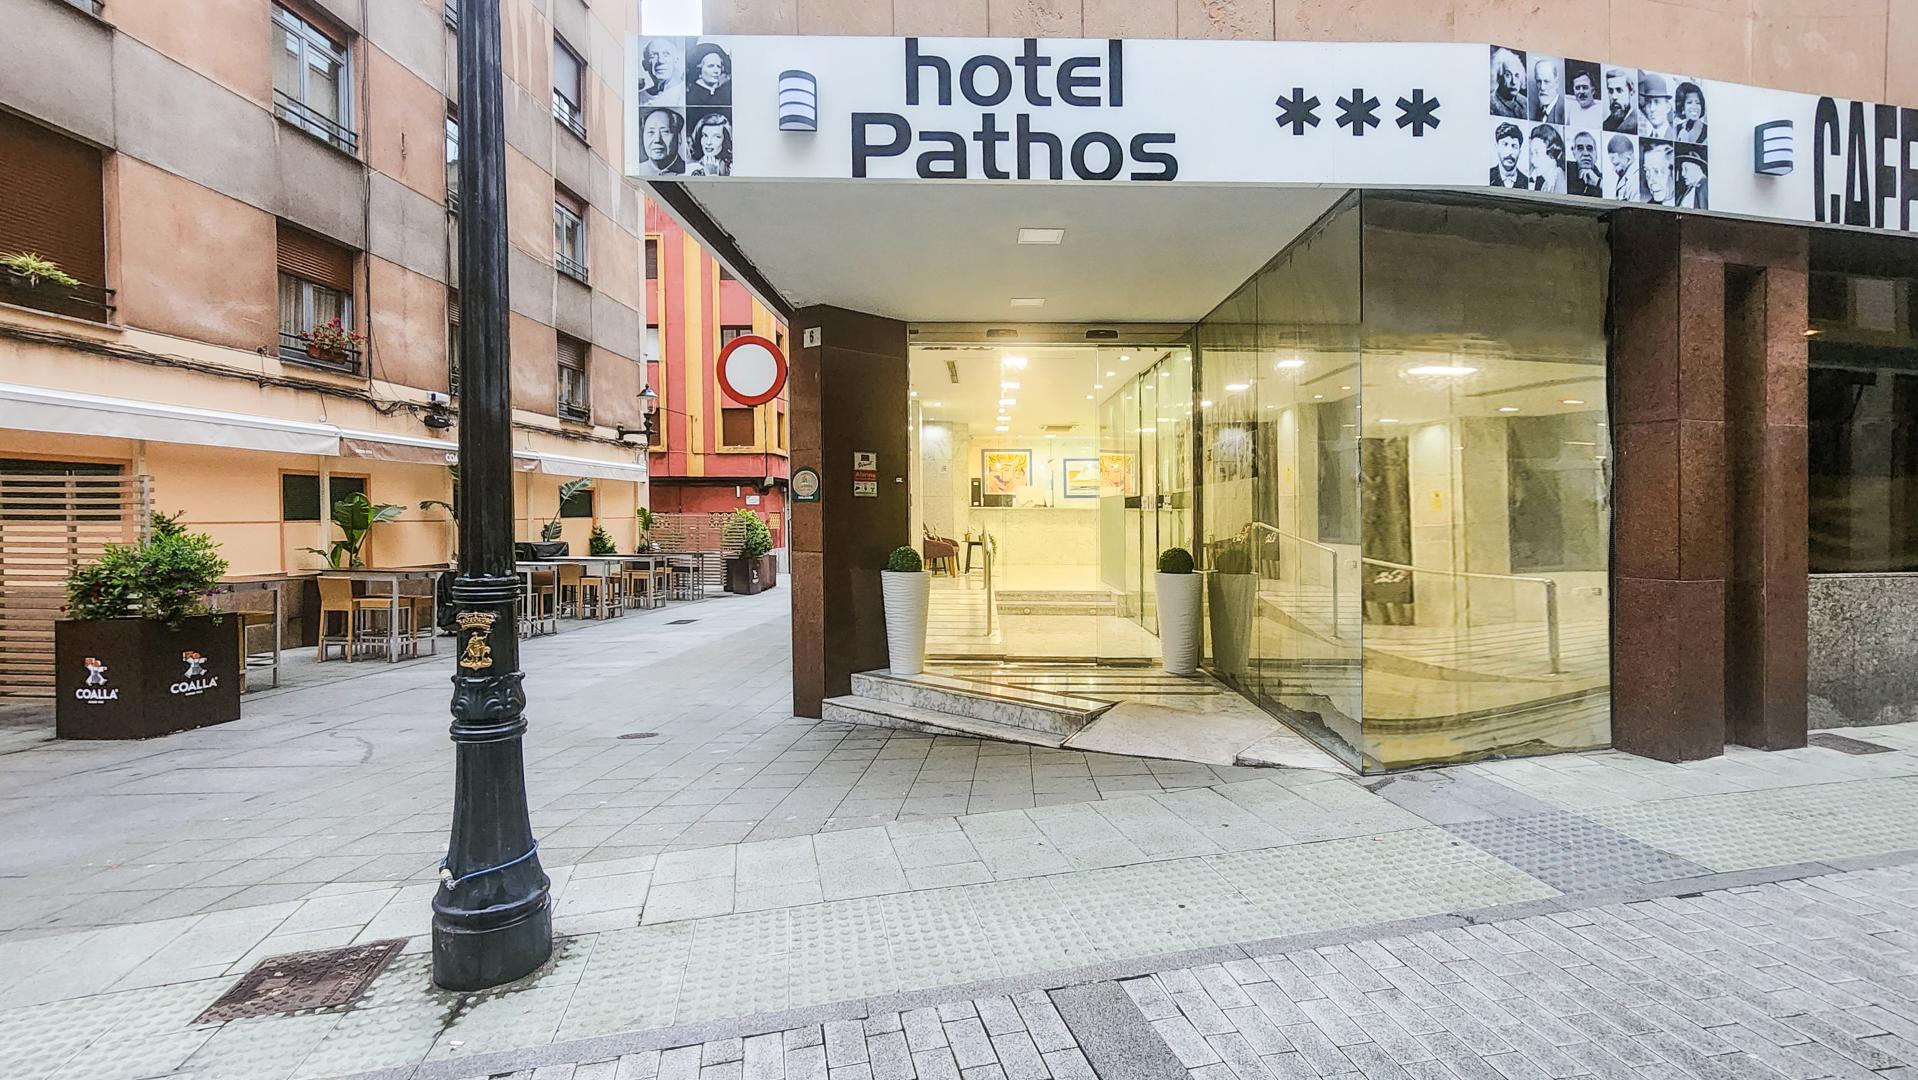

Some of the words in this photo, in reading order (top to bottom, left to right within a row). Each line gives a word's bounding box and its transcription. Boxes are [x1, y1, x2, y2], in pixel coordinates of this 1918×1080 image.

[905, 37, 1123, 107] hotel
[851, 112, 1178, 181] Pathos
[75, 688, 119, 700] COALLA
[170, 677, 218, 694] COALLA
